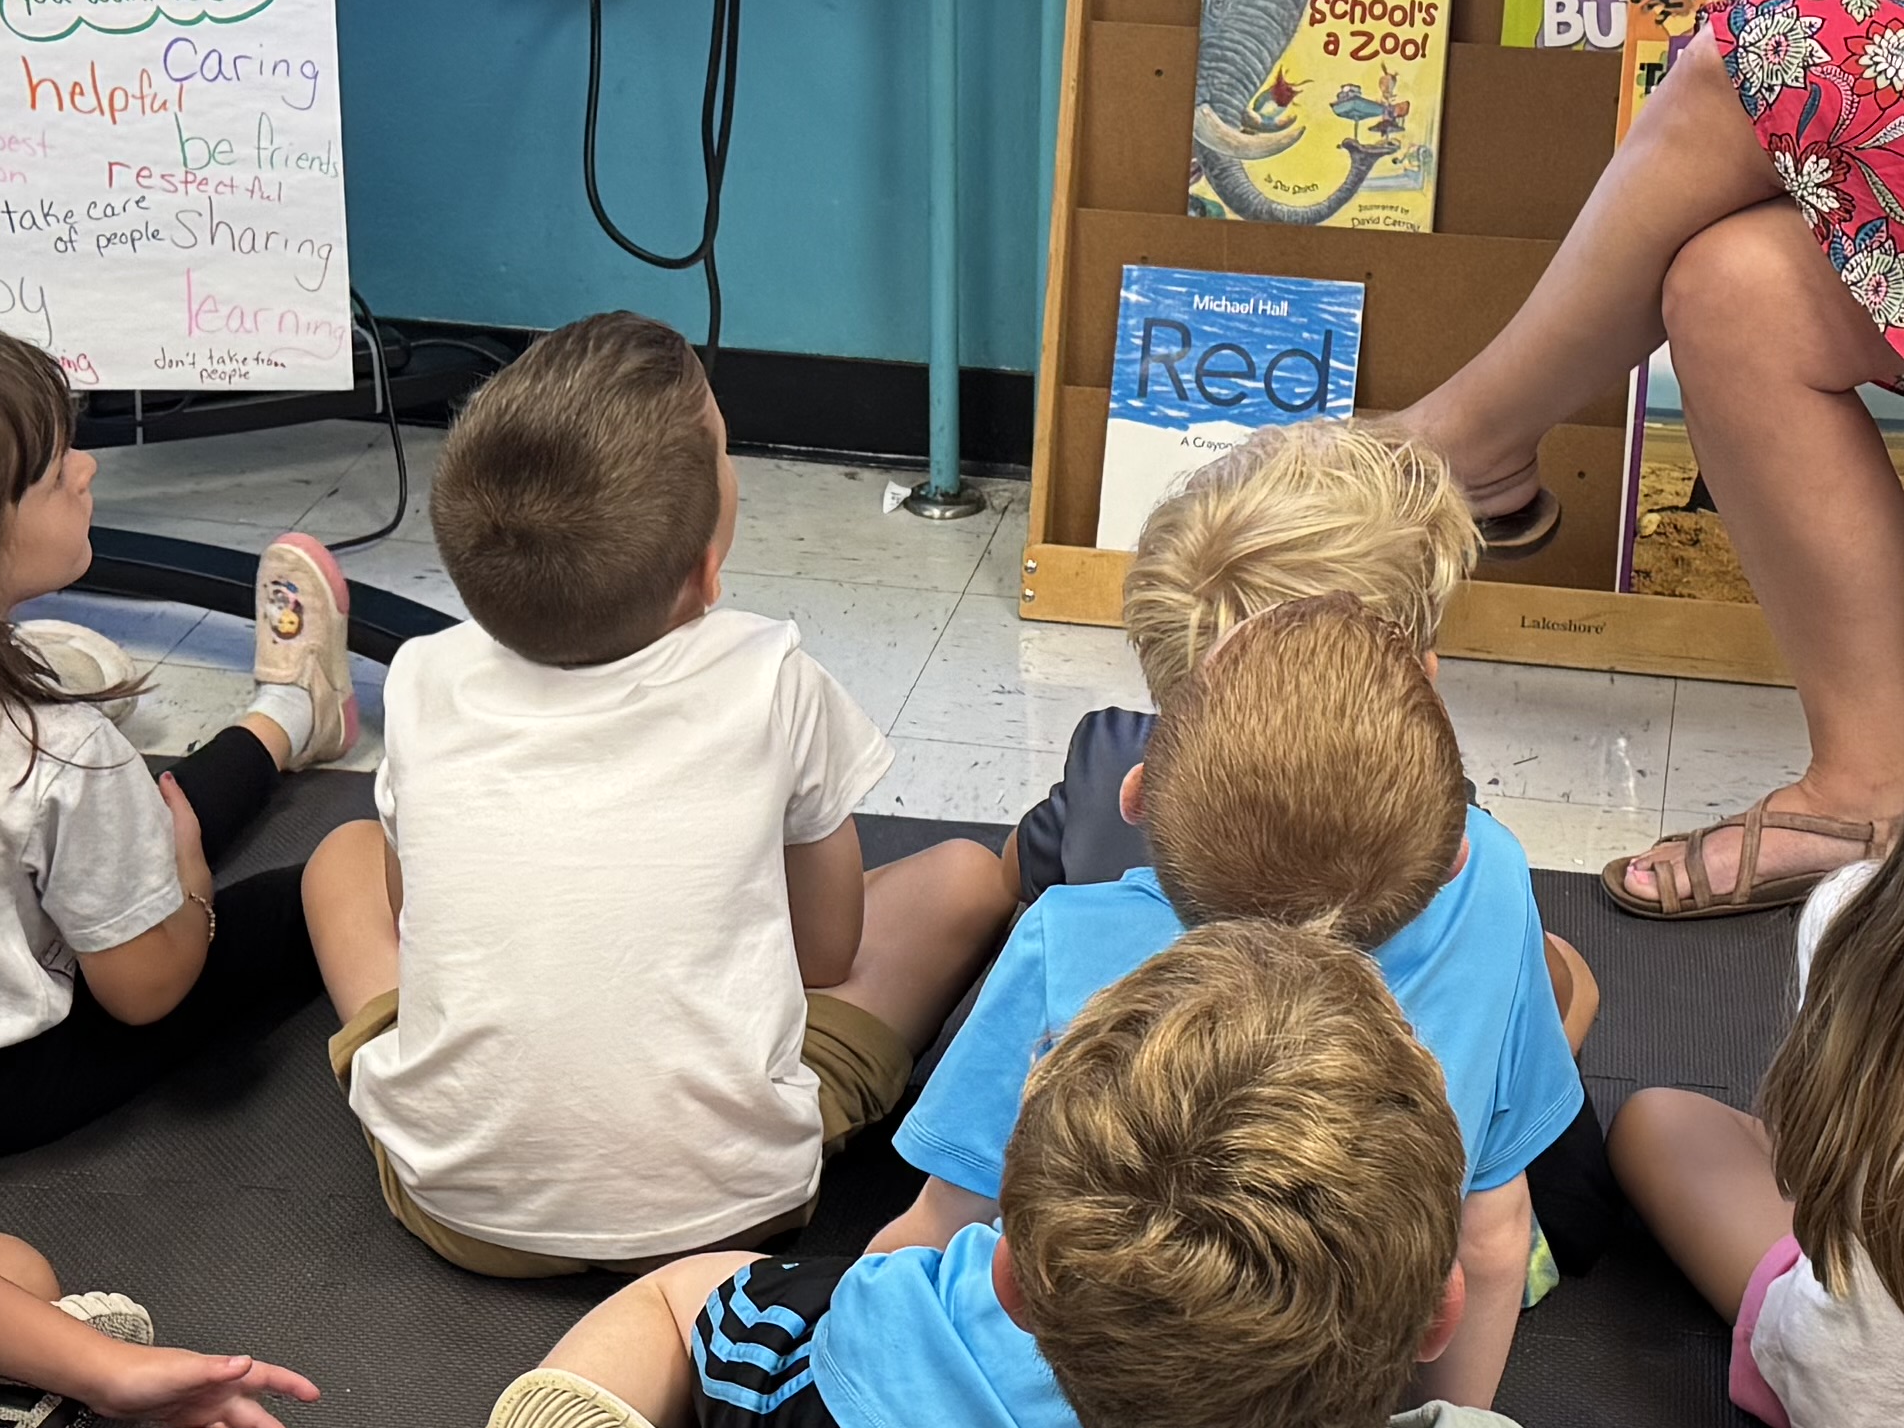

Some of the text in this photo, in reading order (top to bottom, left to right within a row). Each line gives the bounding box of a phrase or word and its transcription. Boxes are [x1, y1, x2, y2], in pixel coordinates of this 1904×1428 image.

[1323, 31, 1430, 61] a Zoo!
[21, 55, 184, 125] helpful
[174, 112, 340, 179] be friends
[1, 195, 151, 234] take care
[54, 221, 166, 257] of people
[186, 268, 346, 361] learning
[1193, 294, 1288, 317] Michael Hall
[207, 347, 248, 367] take
[253, 348, 286, 368] from
[1137, 317, 1333, 413] Red
[199, 368, 250, 385] people
[1180, 436, 1190, 447] A
[1520, 615, 1604, 635] Lakeshore
